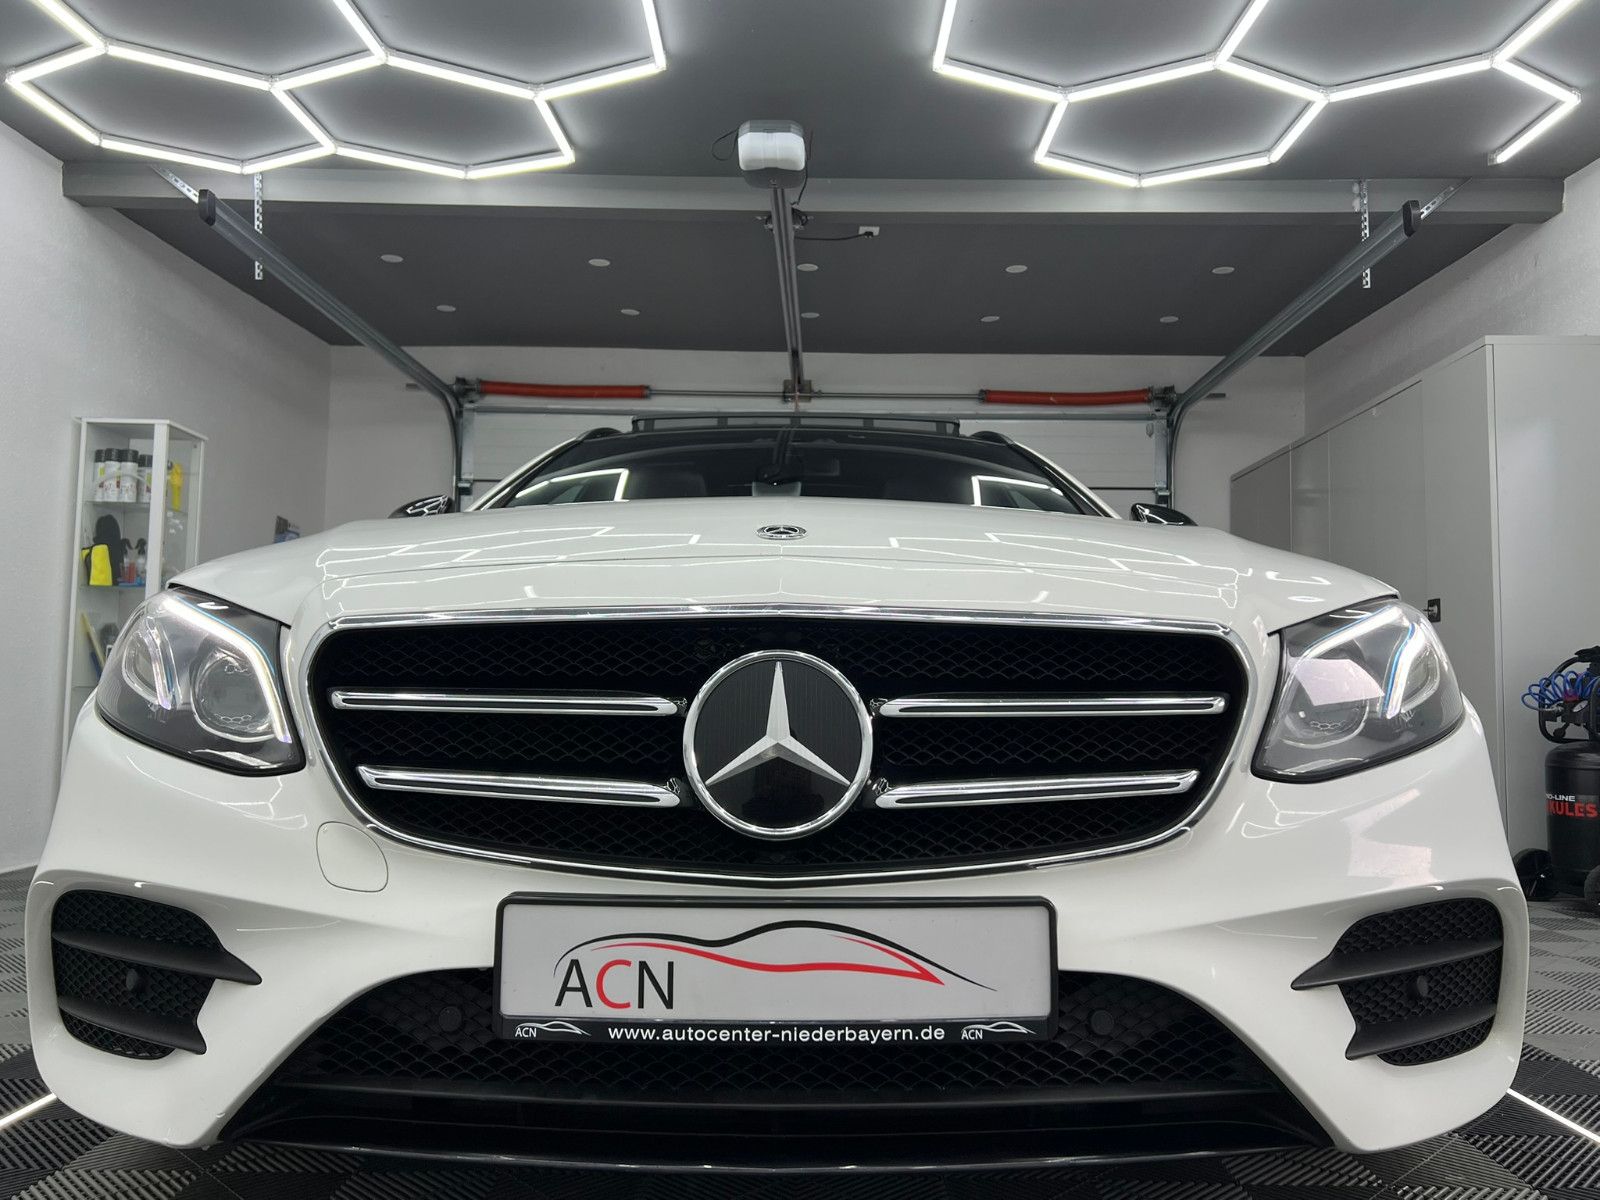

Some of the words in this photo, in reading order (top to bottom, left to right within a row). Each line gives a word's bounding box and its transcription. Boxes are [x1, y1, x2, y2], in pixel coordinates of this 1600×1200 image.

[1546, 800, 1598, 818] KULES
[554, 958, 675, 1010] ACN
[514, 1027, 537, 1037] ACN
[607, 1025, 946, 1044] www.autocenter-niederbayern.de
[961, 1029, 984, 1040] ACN
